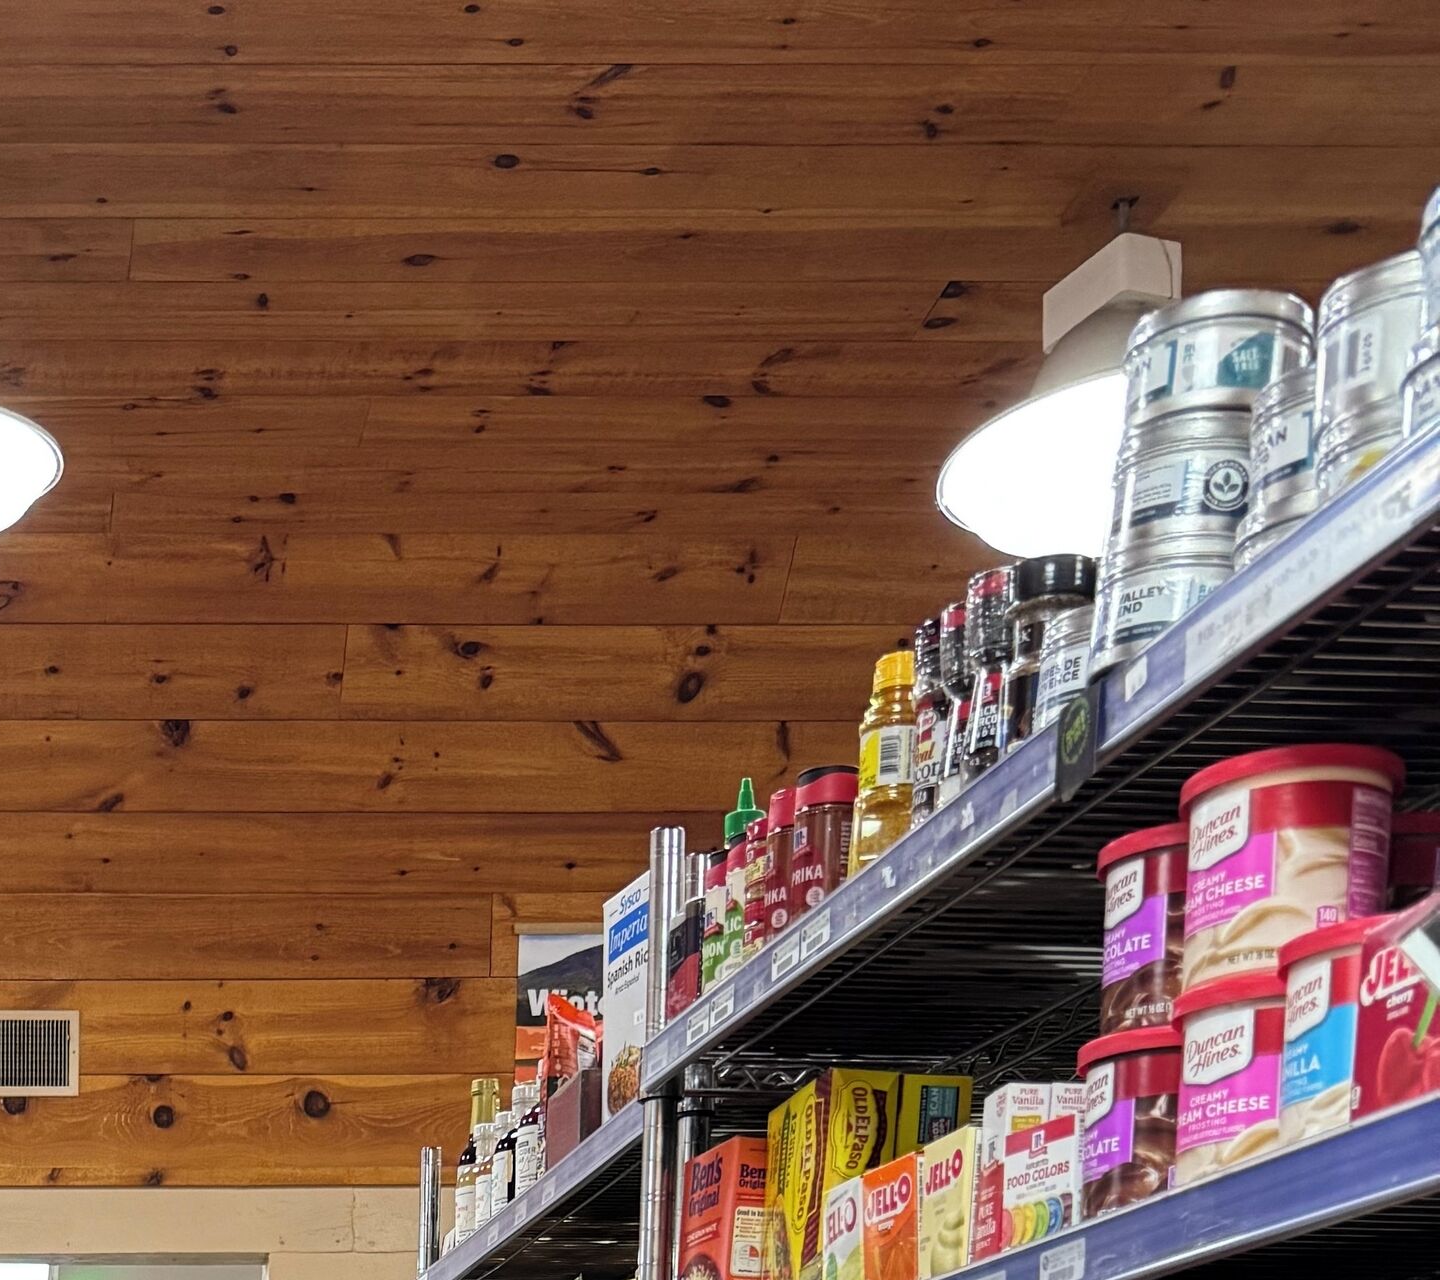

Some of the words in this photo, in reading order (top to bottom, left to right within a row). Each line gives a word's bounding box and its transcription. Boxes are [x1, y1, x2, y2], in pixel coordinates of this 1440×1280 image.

[1191, 804, 1242, 846] Duncan
[1193, 825, 1238, 868] Hines
[620, 887, 641, 915] Sysco
[1206, 872, 1265, 901] CHEESE
[606, 957, 633, 990] Spanish
[1186, 1023, 1246, 1062] Duncan
[1194, 1045, 1243, 1076] Hines
[1190, 1088, 1229, 1109] CREAMY
[1204, 1095, 1270, 1118] CHEESE
[691, 1153, 723, 1194] Ben's
[925, 1148, 964, 1197] JELL-O
[1007, 1168, 1039, 1190] FOOD
[1040, 1160, 1070, 1184] COLORS
[864, 1174, 912, 1220] JELL-O
